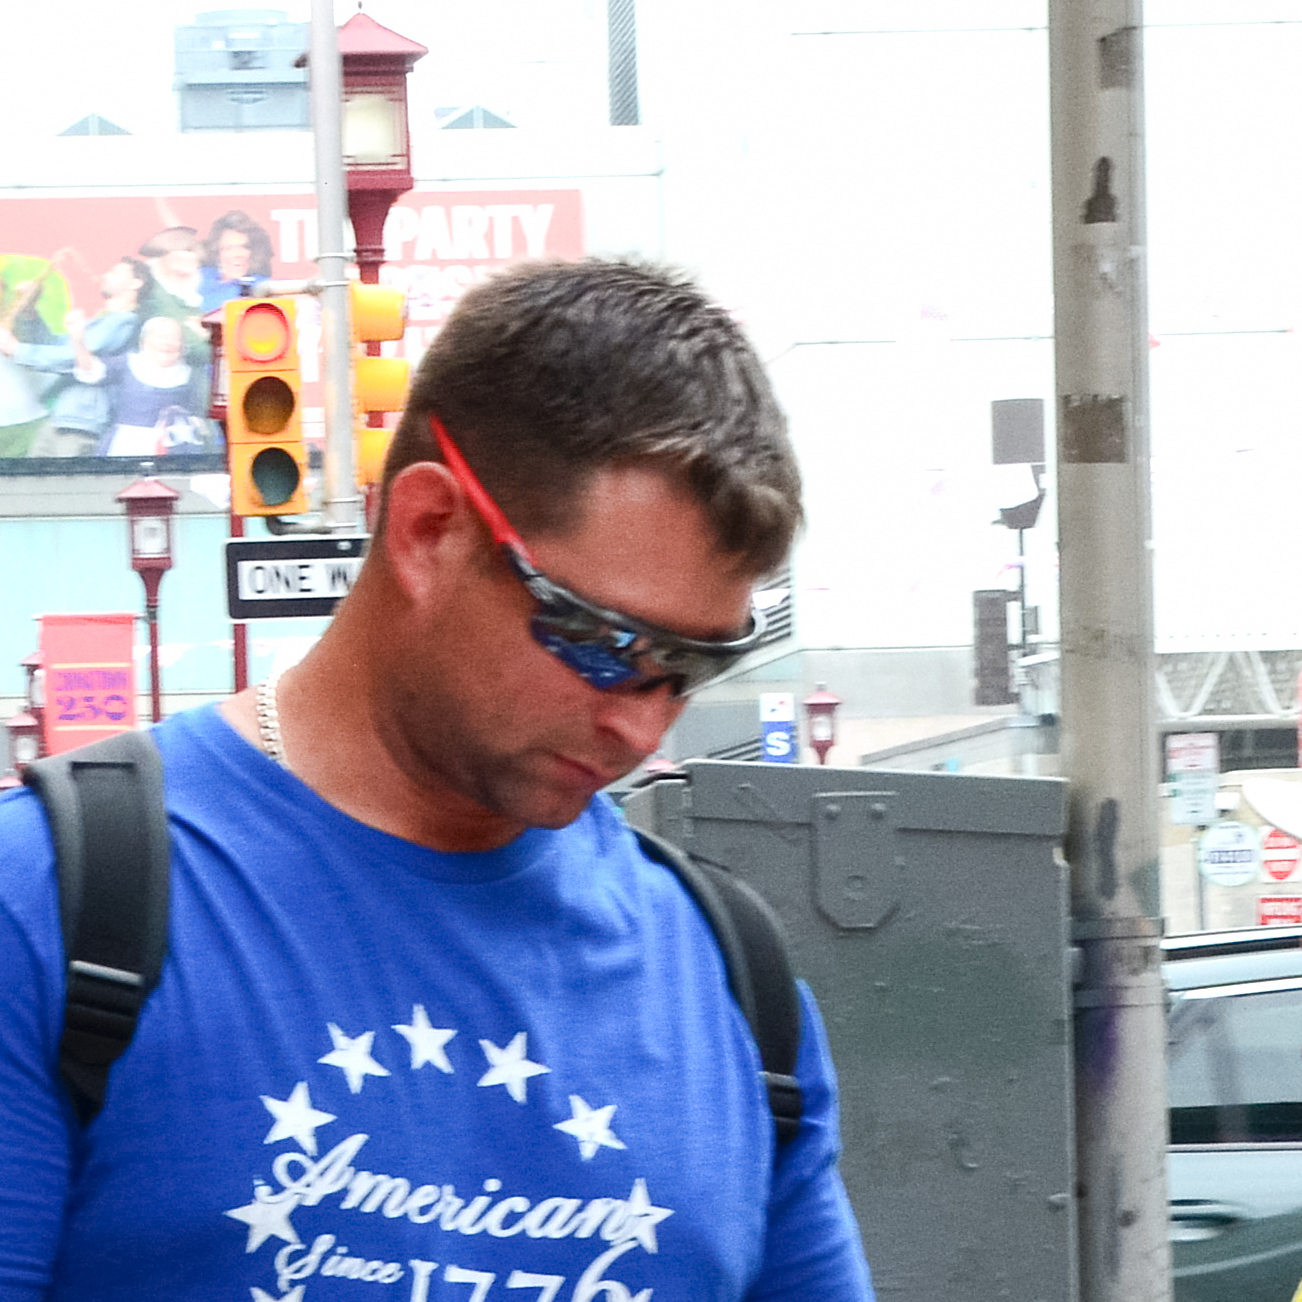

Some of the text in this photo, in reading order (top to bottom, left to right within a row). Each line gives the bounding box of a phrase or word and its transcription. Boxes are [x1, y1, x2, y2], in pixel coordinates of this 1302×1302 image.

[383, 204, 555, 261] PARTY
[251, 564, 317, 594] ONE
[253, 1133, 643, 1246] American
[273, 1233, 404, 1292] Since
